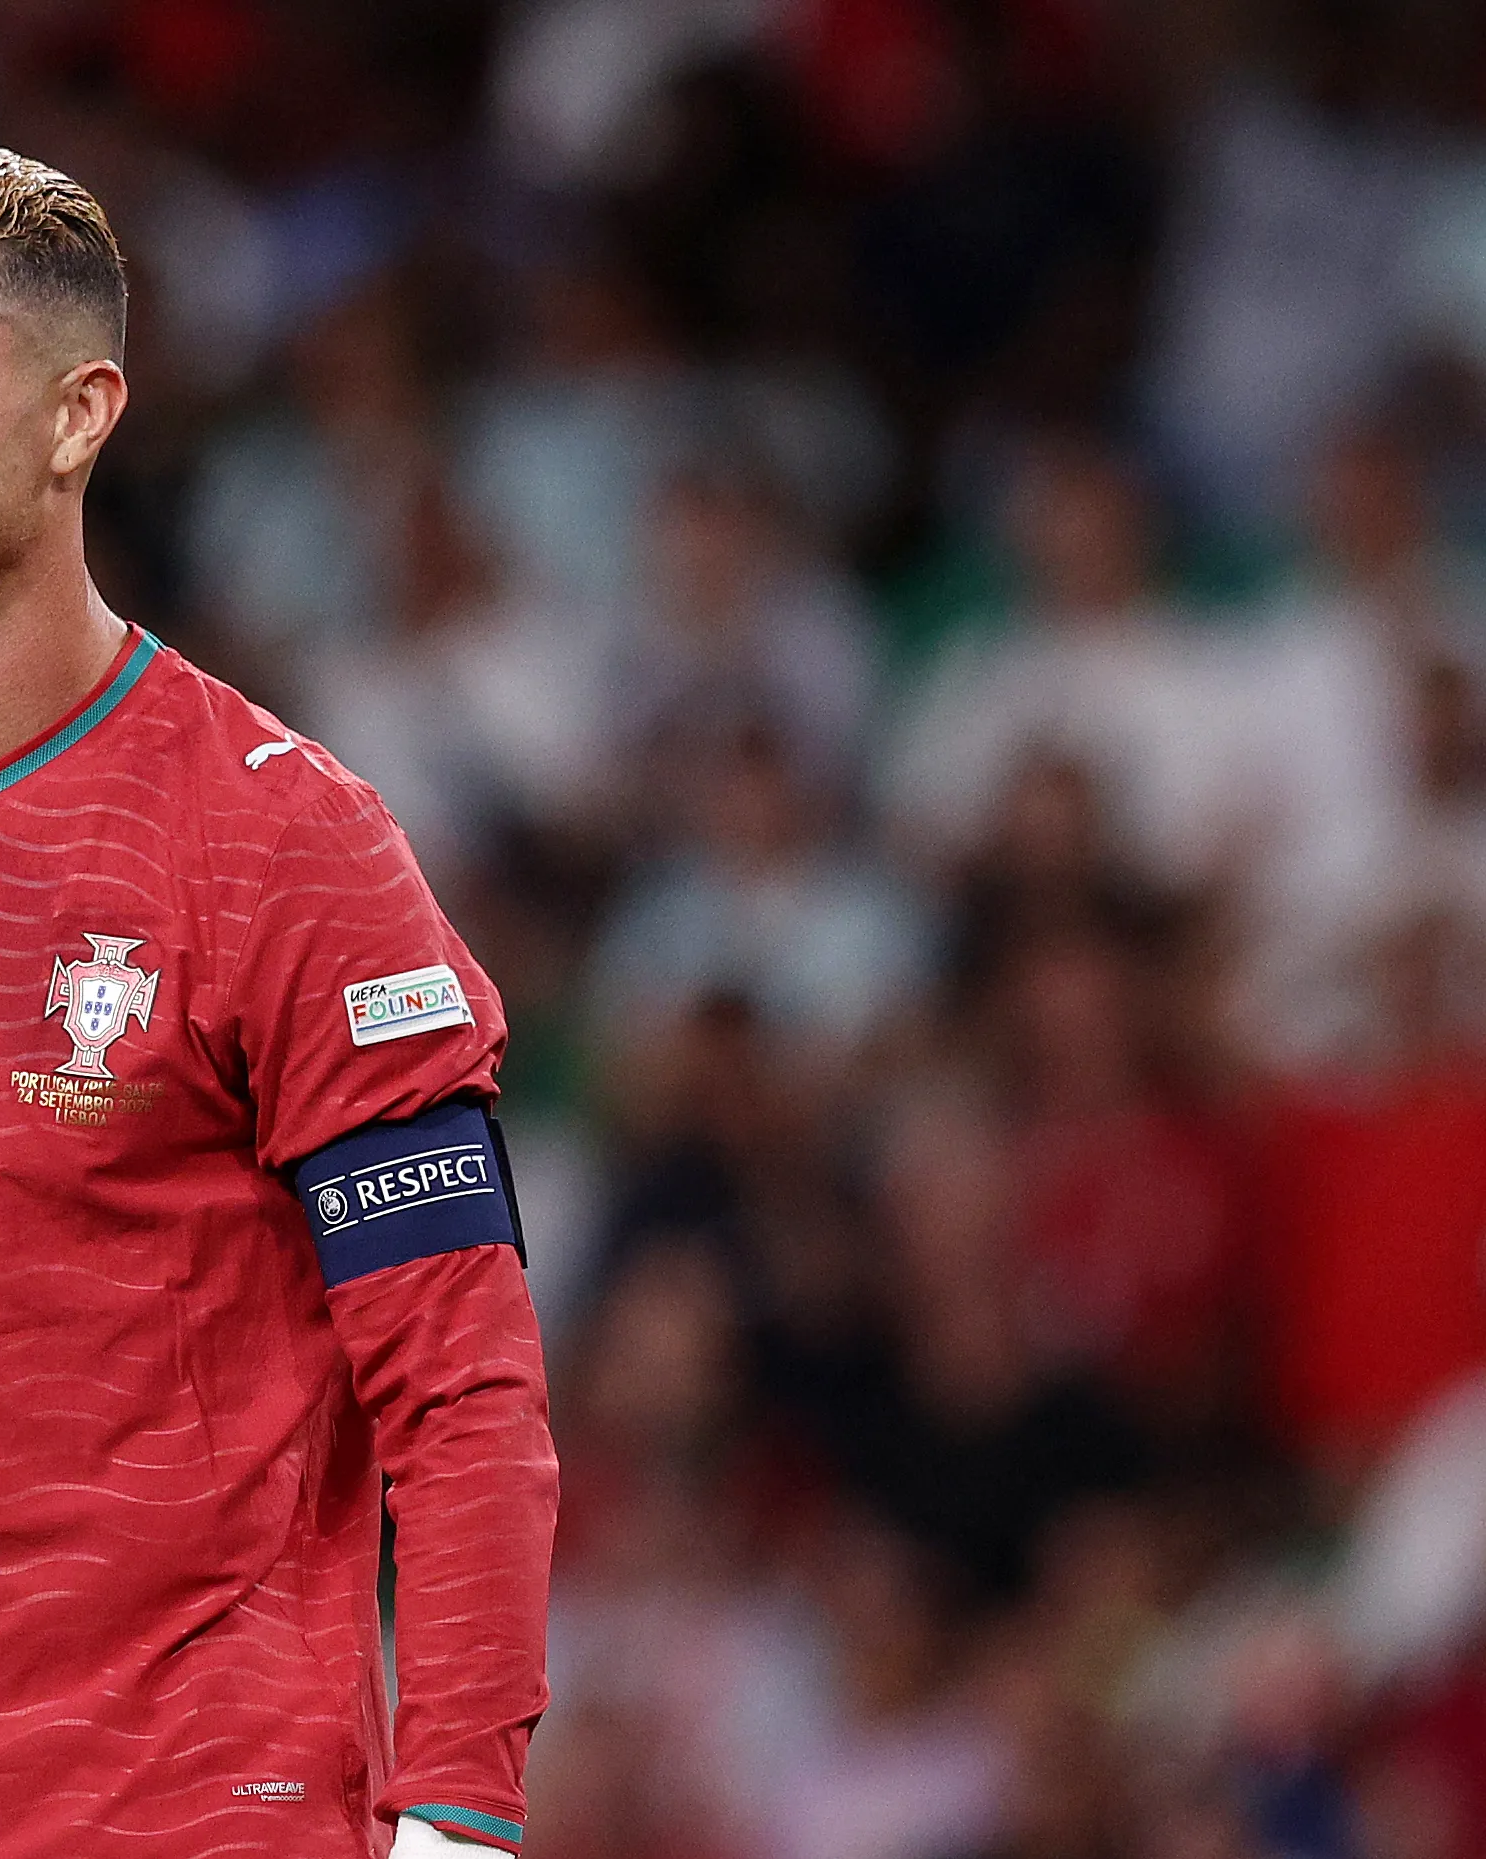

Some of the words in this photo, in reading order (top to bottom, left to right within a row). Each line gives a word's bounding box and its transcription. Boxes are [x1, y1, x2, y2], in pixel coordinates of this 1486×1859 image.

[350, 984, 387, 1002] UEFA
[17, 1088, 34, 1104] 24
[39, 1091, 114, 1112] SETEMBRO
[55, 1108, 107, 1126] LISBOA
[355, 1155, 487, 1209] RESPECT
[232, 1782, 305, 1796] ULTRAWEAVE
